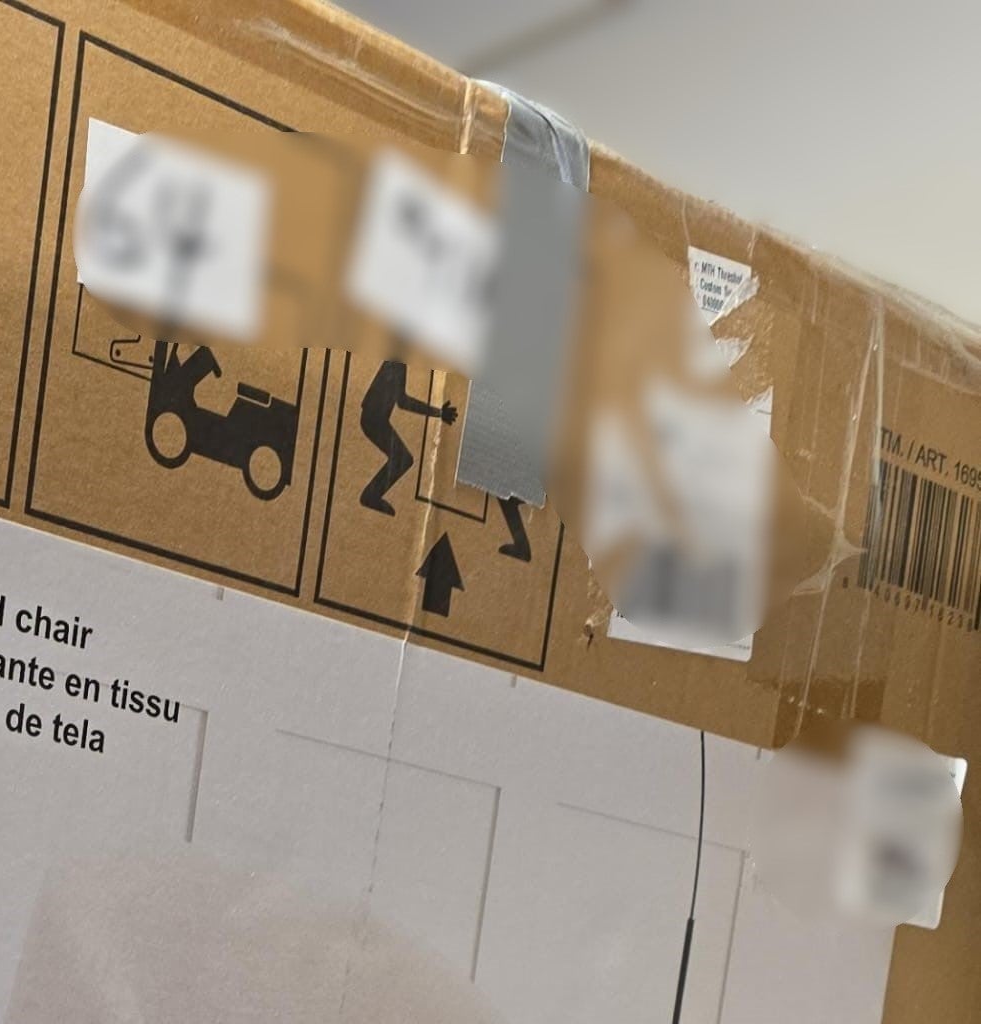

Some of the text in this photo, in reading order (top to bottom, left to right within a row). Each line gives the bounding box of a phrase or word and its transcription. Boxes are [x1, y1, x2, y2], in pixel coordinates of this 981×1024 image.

[880, 427, 903, 456] TM.
[915, 443, 948, 476] ART.
[16, 606, 93, 649] chair
[65, 673, 100, 701] en
[111, 679, 180, 723] tissu
[5, 703, 42, 736] de
[52, 713, 106, 753] tela
